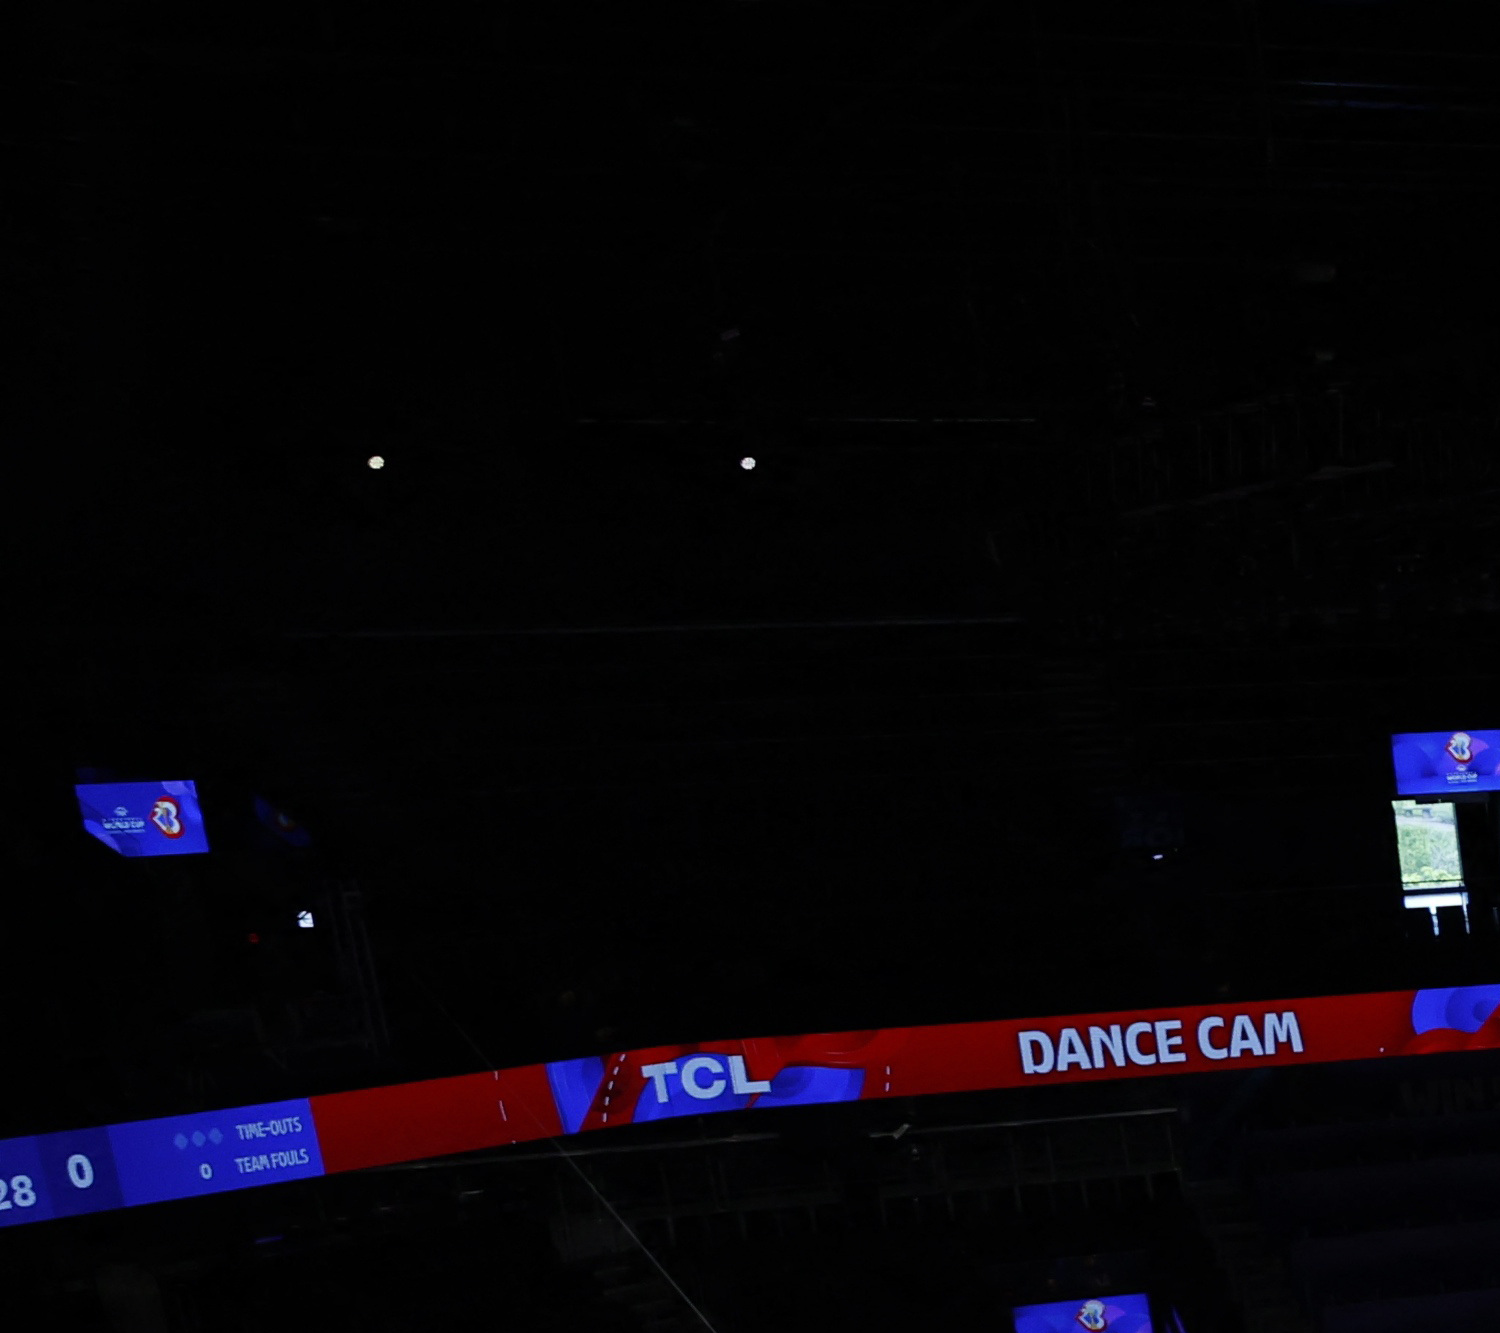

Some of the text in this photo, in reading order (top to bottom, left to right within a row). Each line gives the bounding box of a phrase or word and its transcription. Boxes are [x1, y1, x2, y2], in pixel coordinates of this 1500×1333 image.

[1019, 1012, 1303, 1073] DANCE CAM
[642, 1056, 770, 1103] TCL
[236, 1117, 302, 1140] TIME-OUTS
[68, 1155, 93, 1188] 0
[235, 1149, 309, 1173] TEAM FOULS
